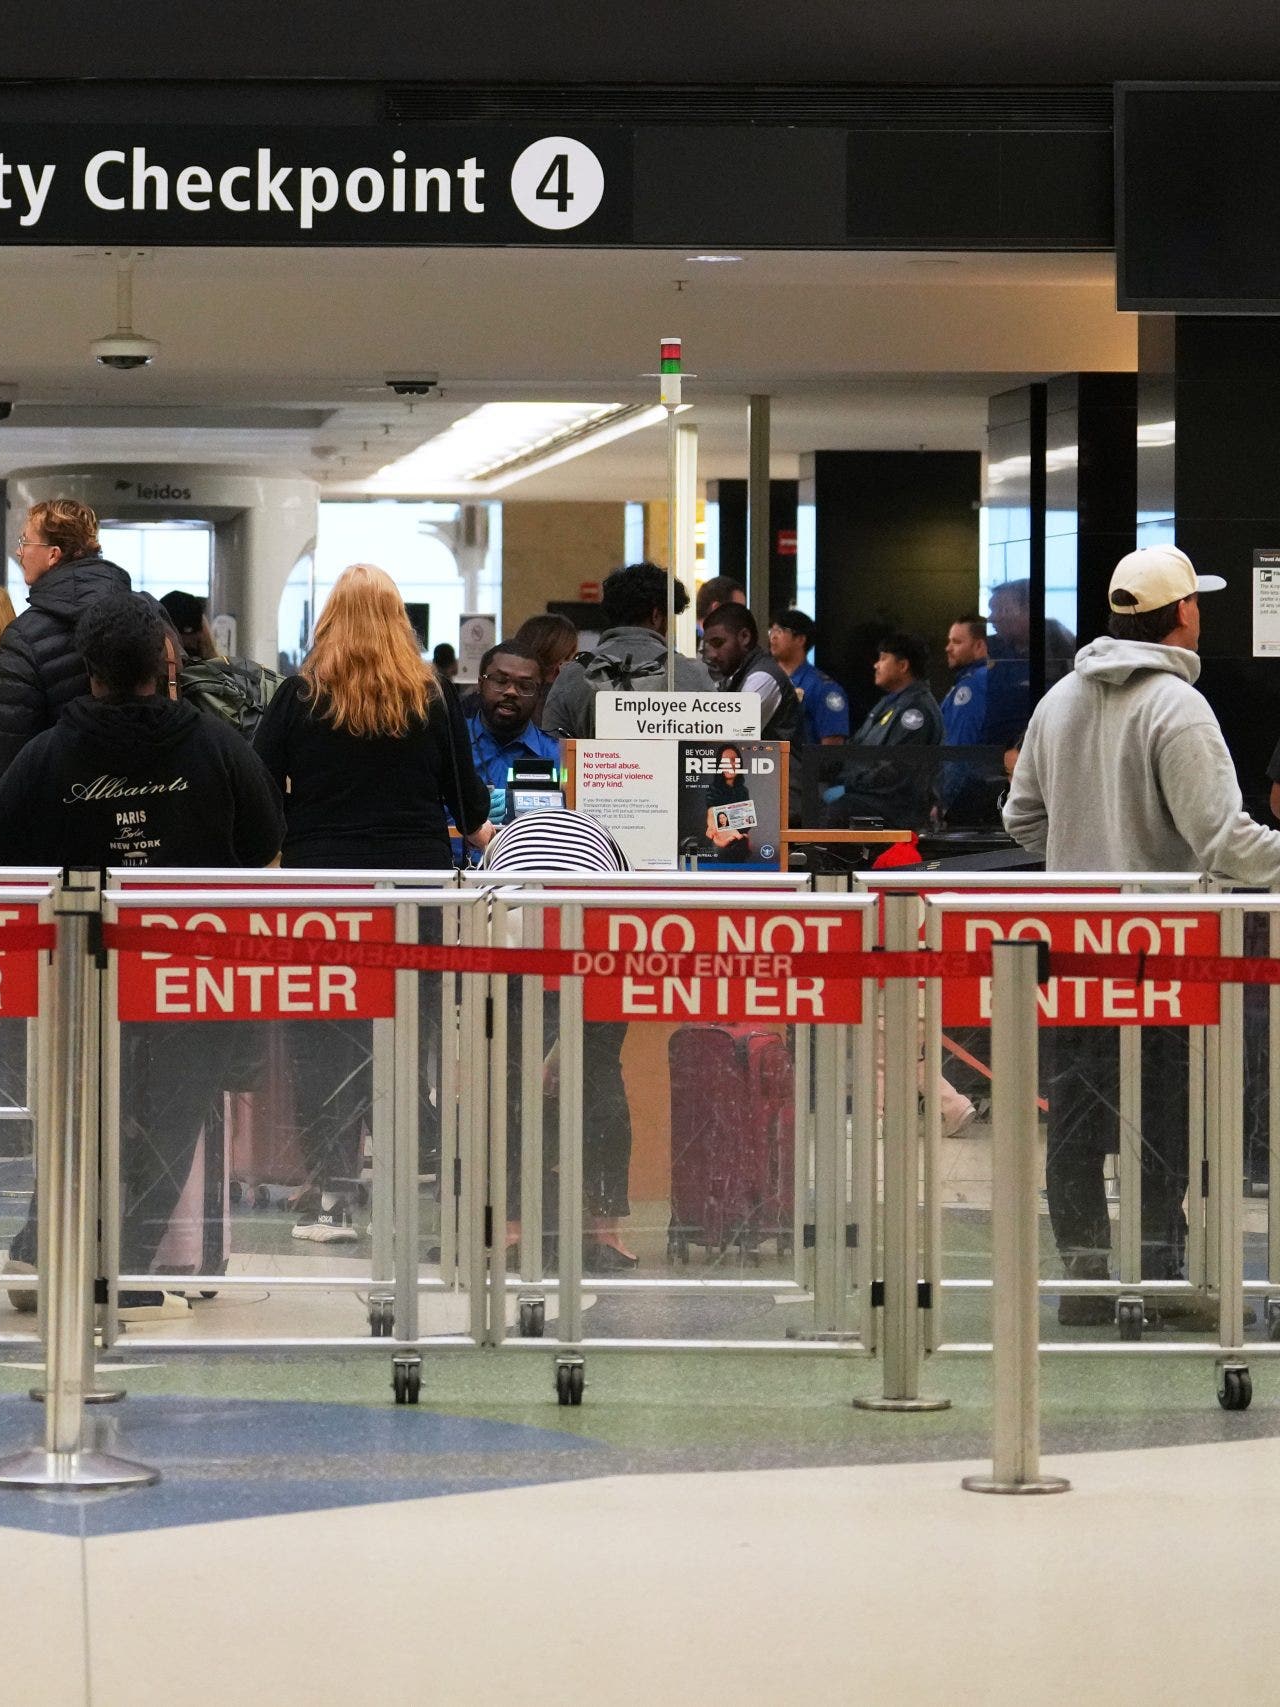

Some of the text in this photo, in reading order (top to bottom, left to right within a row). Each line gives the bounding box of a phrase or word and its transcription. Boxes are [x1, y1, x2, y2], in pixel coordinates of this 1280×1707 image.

[84, 147, 485, 228] Checkpoint
[535, 153, 575, 213] 4
[137, 483, 191, 499] leidos
[615, 697, 742, 715] Employee Access
[636, 719, 724, 734] Verification
[595, 772, 622, 781] physical
[685, 757, 775, 774] REAL ID
[62, 774, 190, 803] Allsaints
[116, 810, 147, 825] PARIS
[110, 839, 161, 850] NEW YORK
[608, 914, 842, 953] DO NOT
[1074, 918, 1198, 957] NOT
[572, 952, 793, 978] DO NOT ENTER
[155, 965, 358, 1014] ENTER
[623, 976, 824, 1017] ENTER
